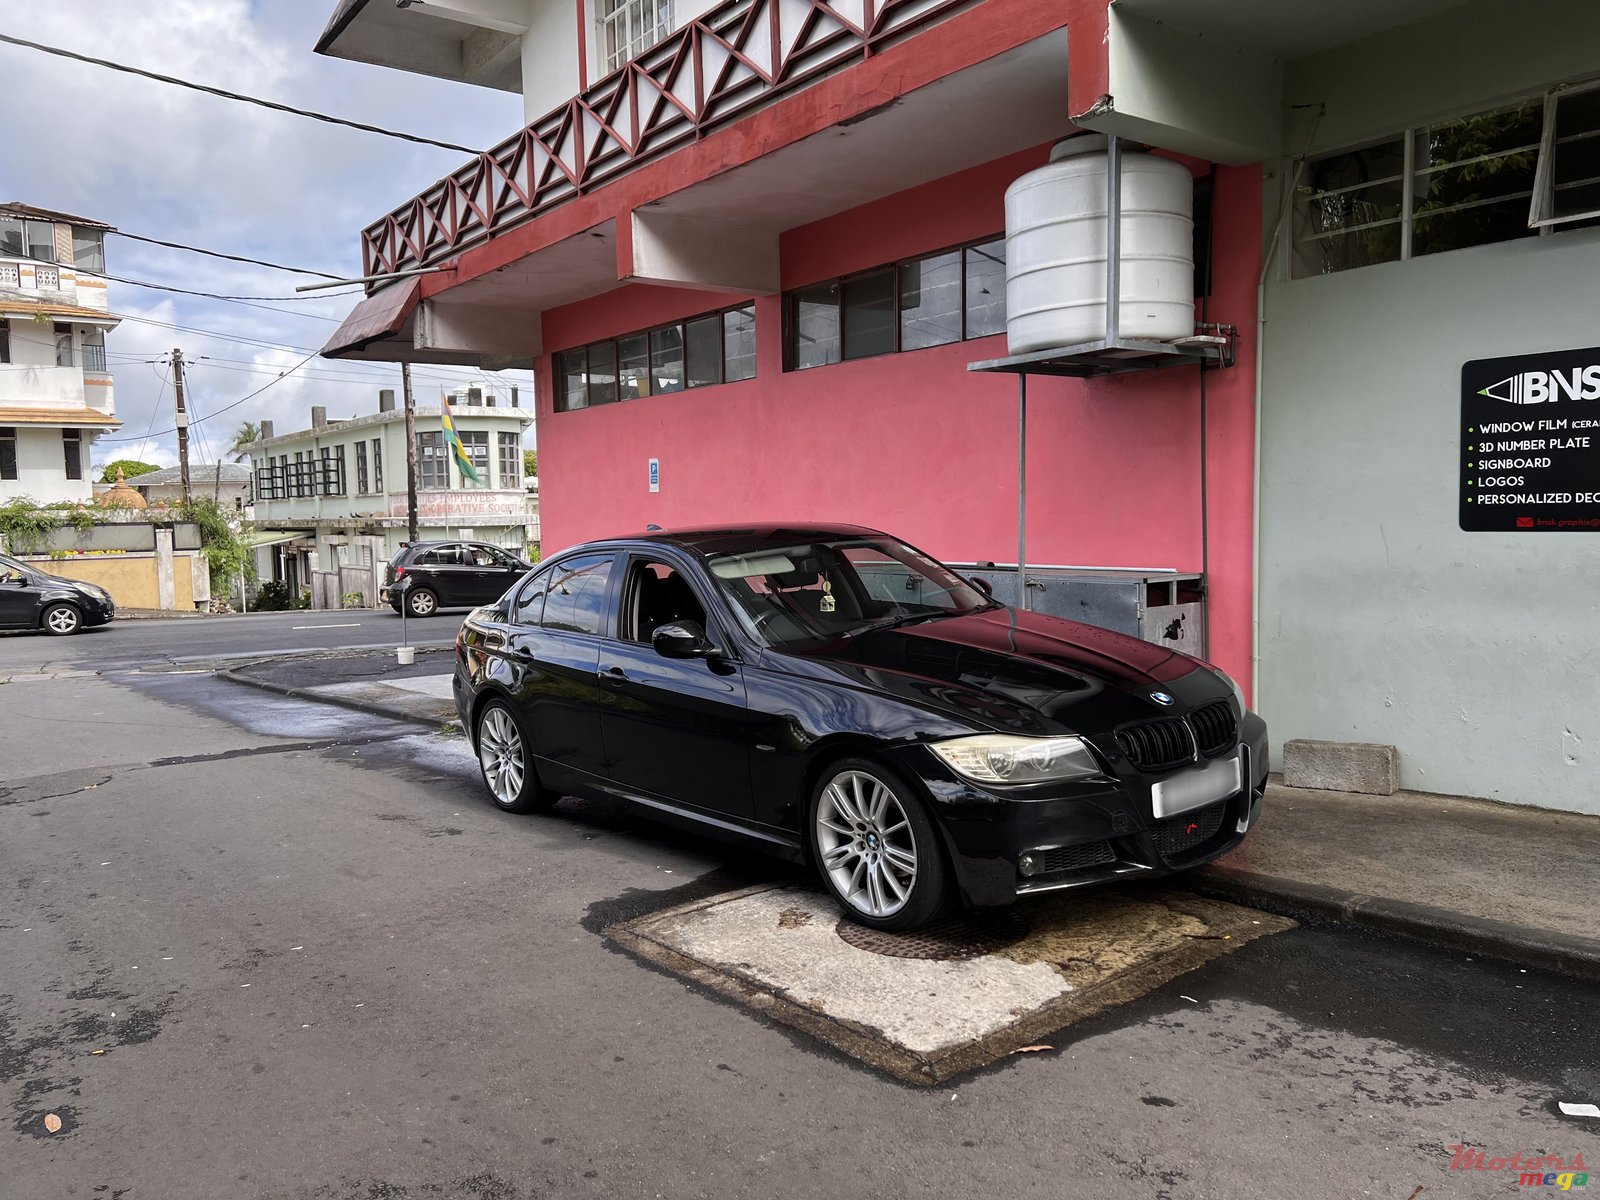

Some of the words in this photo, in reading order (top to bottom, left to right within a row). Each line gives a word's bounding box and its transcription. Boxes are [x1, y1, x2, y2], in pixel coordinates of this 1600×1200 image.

[1479, 420, 1535, 434] WINDOW
[1538, 418, 1568, 431] FILM
[1571, 419, 1600, 429] (CERA
[1479, 442, 1494, 453] 3D
[1497, 439, 1546, 452] NUMBER
[1549, 437, 1591, 450] PLATE
[1478, 457, 1551, 470] SIGNBOARD
[1478, 476, 1525, 488] LOGOS
[1477, 492, 1572, 505] PERSONALIZED
[1536, 518, 1600, 528] bnsk.graphix@
